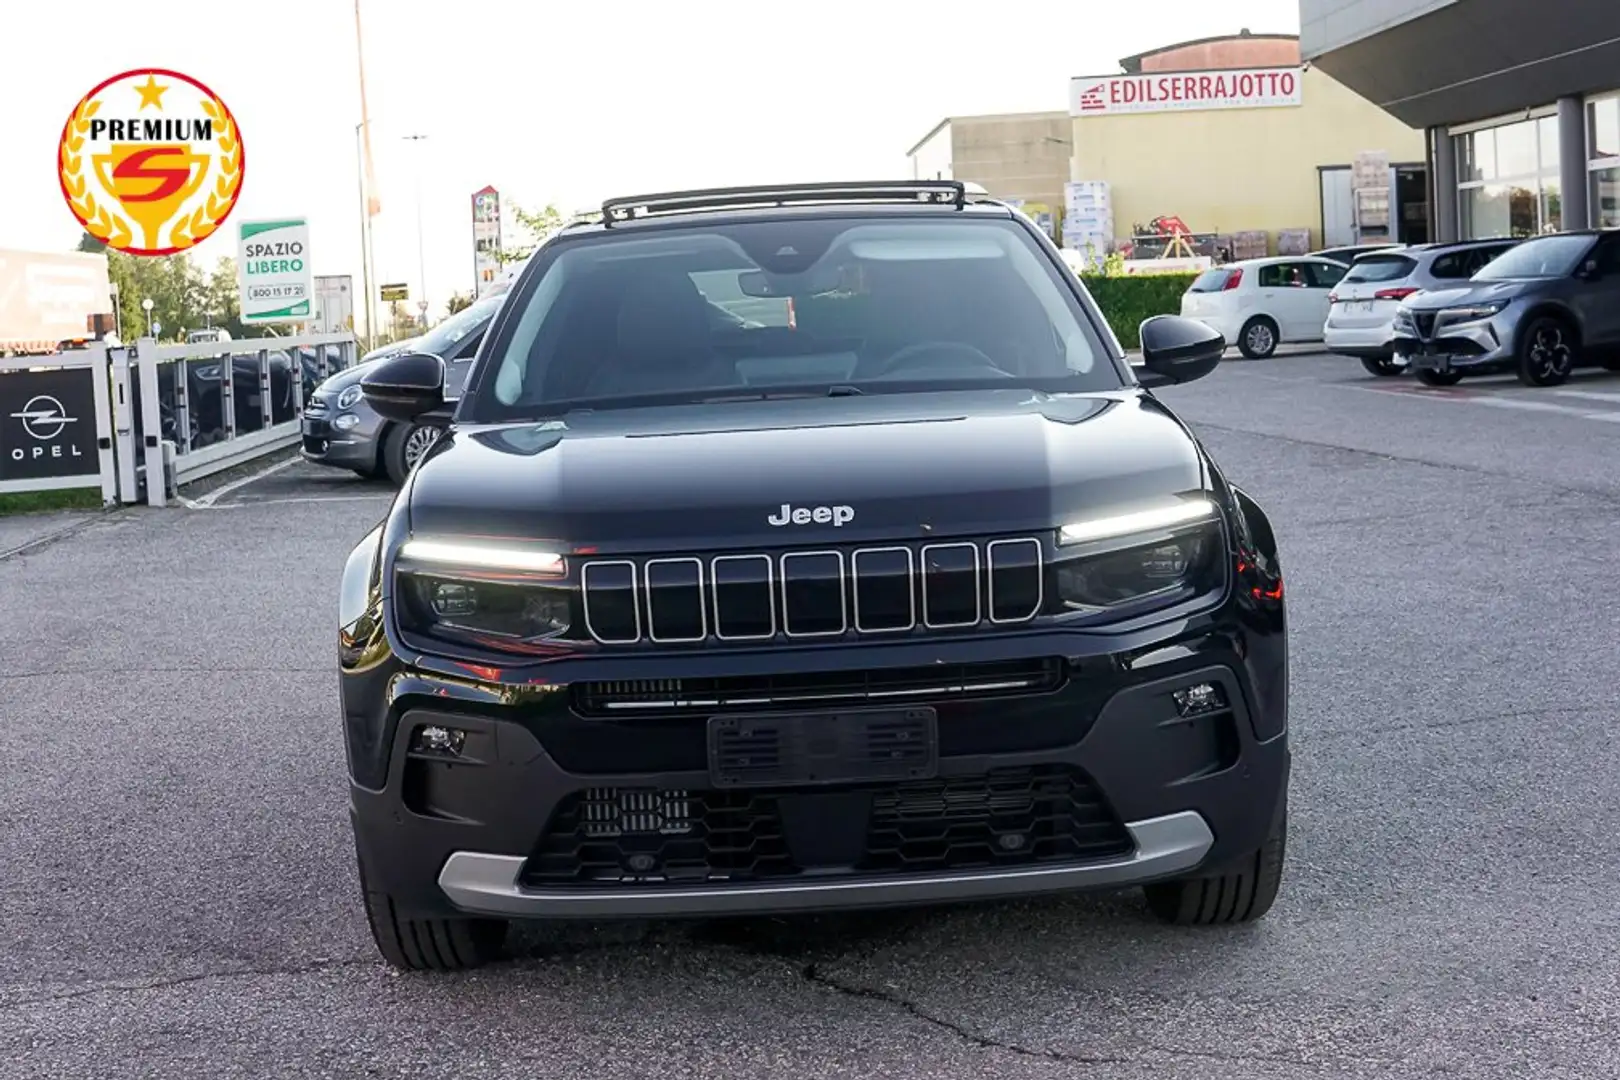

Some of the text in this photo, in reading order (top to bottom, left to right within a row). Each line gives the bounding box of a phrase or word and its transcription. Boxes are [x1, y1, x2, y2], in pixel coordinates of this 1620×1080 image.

[1110, 72, 1295, 104] EDILSERRAJOTTO
[246, 242, 303, 257] SPAZIO
[247, 259, 303, 274] LIBERO
[253, 288, 271, 297] 800
[11, 443, 82, 461] OPEL
[767, 503, 855, 527] Jeep
